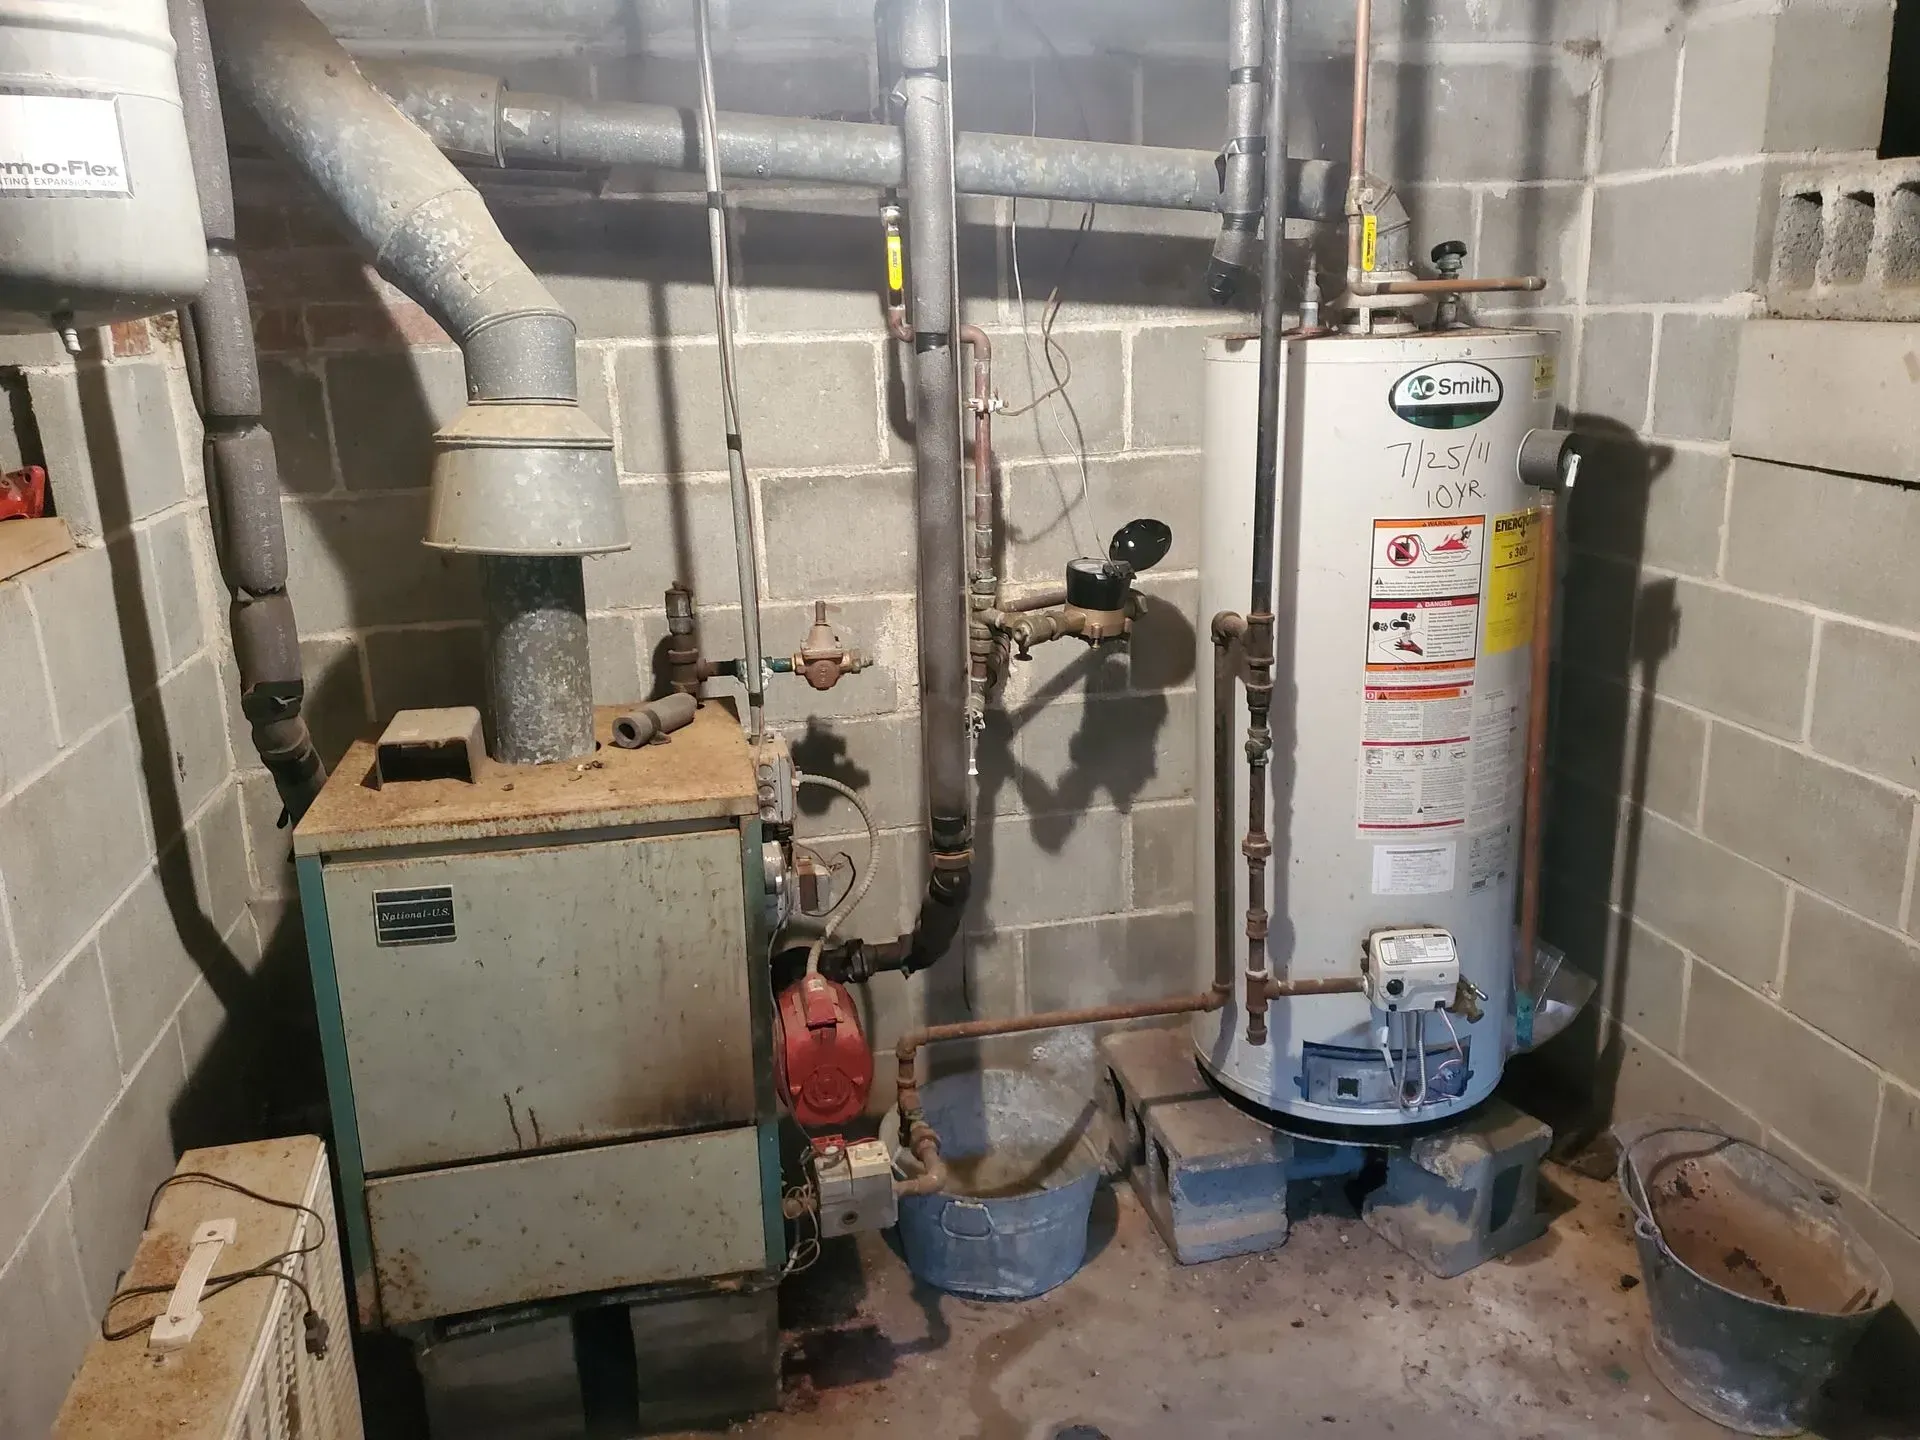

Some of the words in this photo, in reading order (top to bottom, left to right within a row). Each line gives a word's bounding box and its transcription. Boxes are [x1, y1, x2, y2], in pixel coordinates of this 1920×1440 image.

[34, 177, 92, 187] EXPANSION
[1438, 376, 1491, 396] Smith
[1387, 433, 1490, 488] 7/25/11
[1425, 600, 1453, 608] DANGER
[381, 908, 451, 922] National-U.S.
